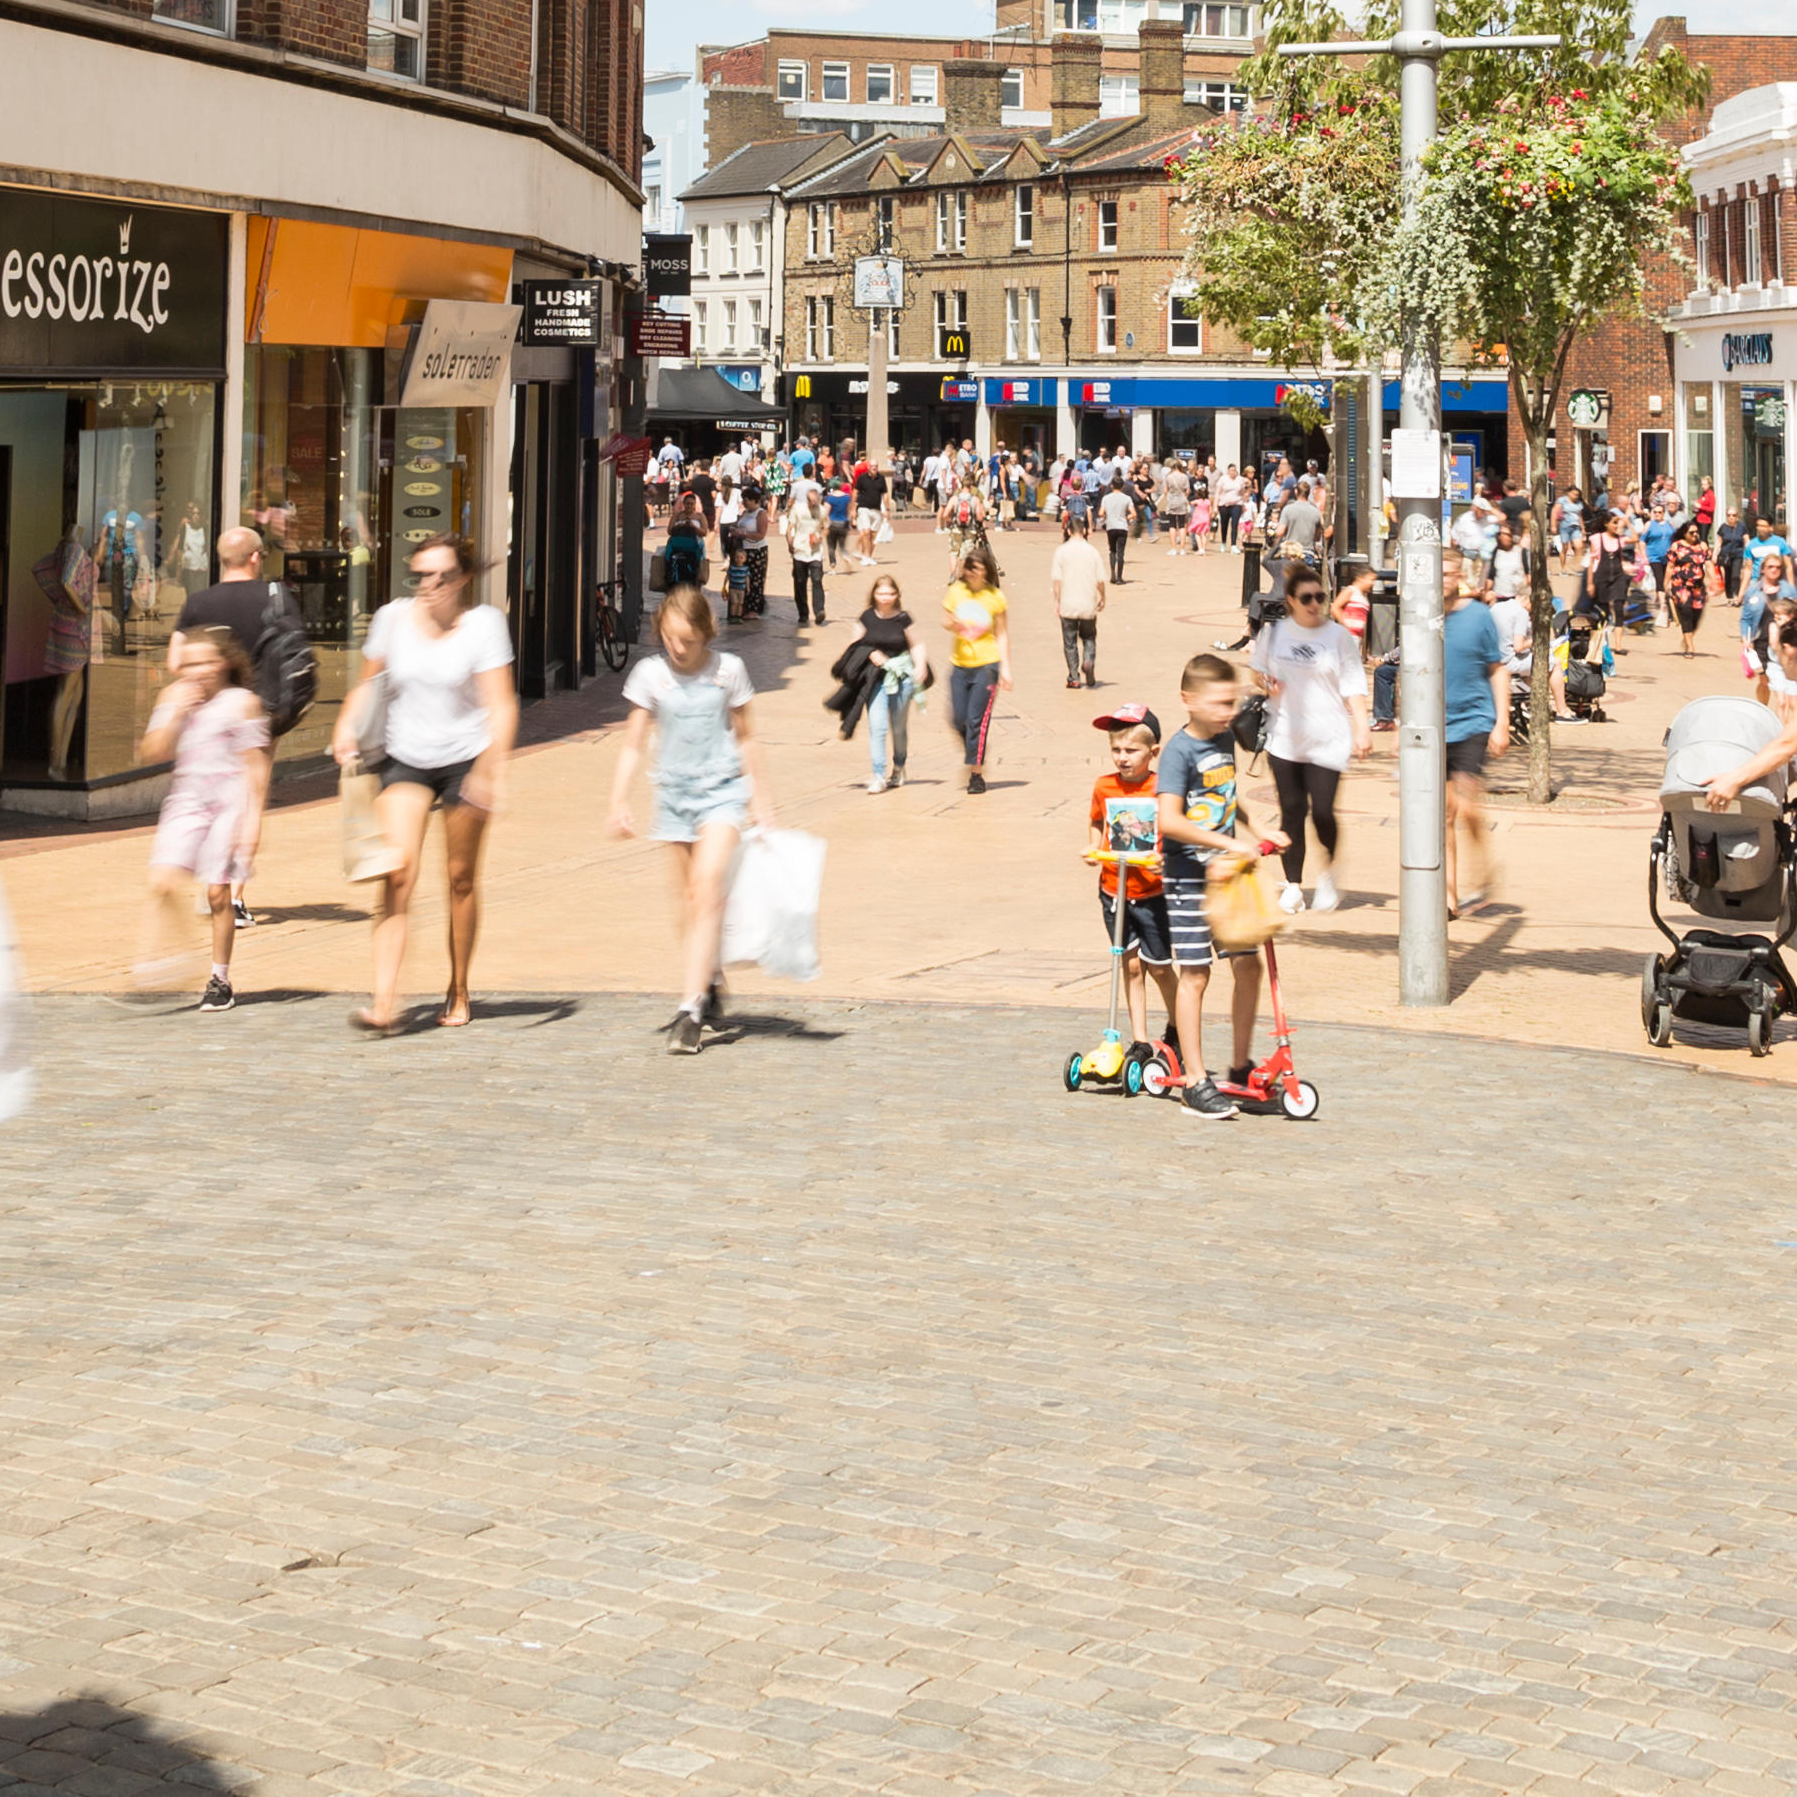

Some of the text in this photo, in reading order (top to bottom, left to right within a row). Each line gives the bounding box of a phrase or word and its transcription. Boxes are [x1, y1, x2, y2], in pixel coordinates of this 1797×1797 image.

[650, 259, 689, 270] MOSS
[535, 290, 591, 306] LUSH
[546, 308, 580, 317] FRESH
[534, 318, 591, 327] HANDMADE
[533, 328, 592, 337] COSMETICS
[1730, 333, 1773, 365] BARCLAYS
[291, 446, 323, 459] SALE
